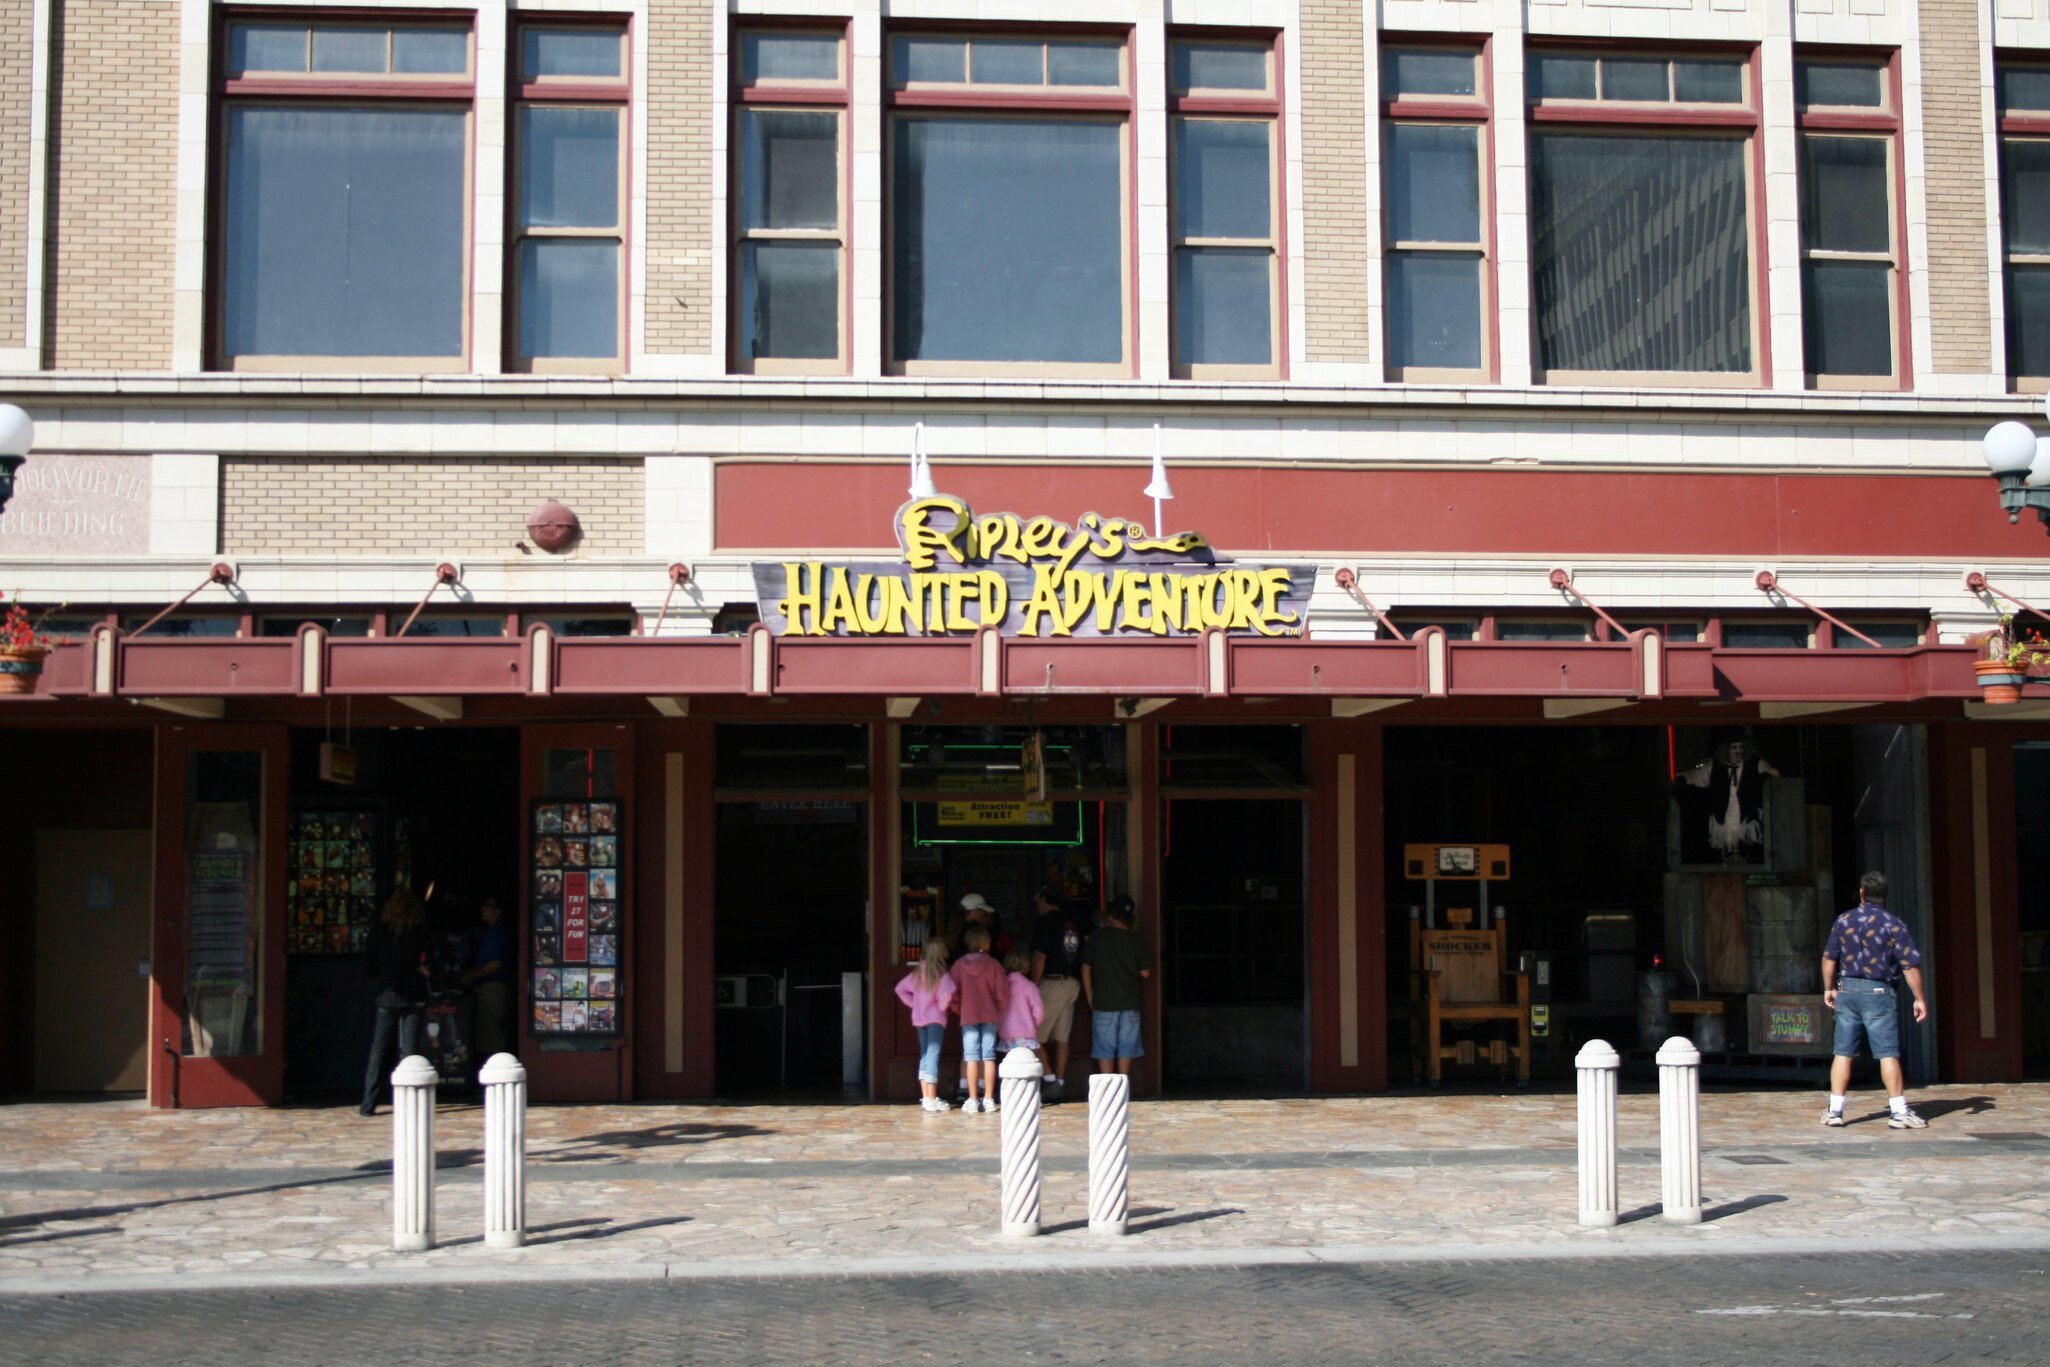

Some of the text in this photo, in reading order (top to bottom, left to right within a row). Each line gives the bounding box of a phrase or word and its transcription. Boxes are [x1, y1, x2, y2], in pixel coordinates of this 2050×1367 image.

[13, 465, 144, 501] OOLWORTH
[779, 561, 1008, 637] HAUNTED
[1016, 563, 1299, 637] ADVENTURE
[970, 802, 1021, 810] Attraction
[979, 811, 1012, 819] FREE!
[567, 895, 585, 903] TRY
[571, 907, 583, 915] IT
[567, 918, 585, 927] FOR
[567, 930, 585, 939] FUN
[1428, 942, 1492, 951] SHOCKER
[1770, 1012, 1809, 1024] TALK TO
